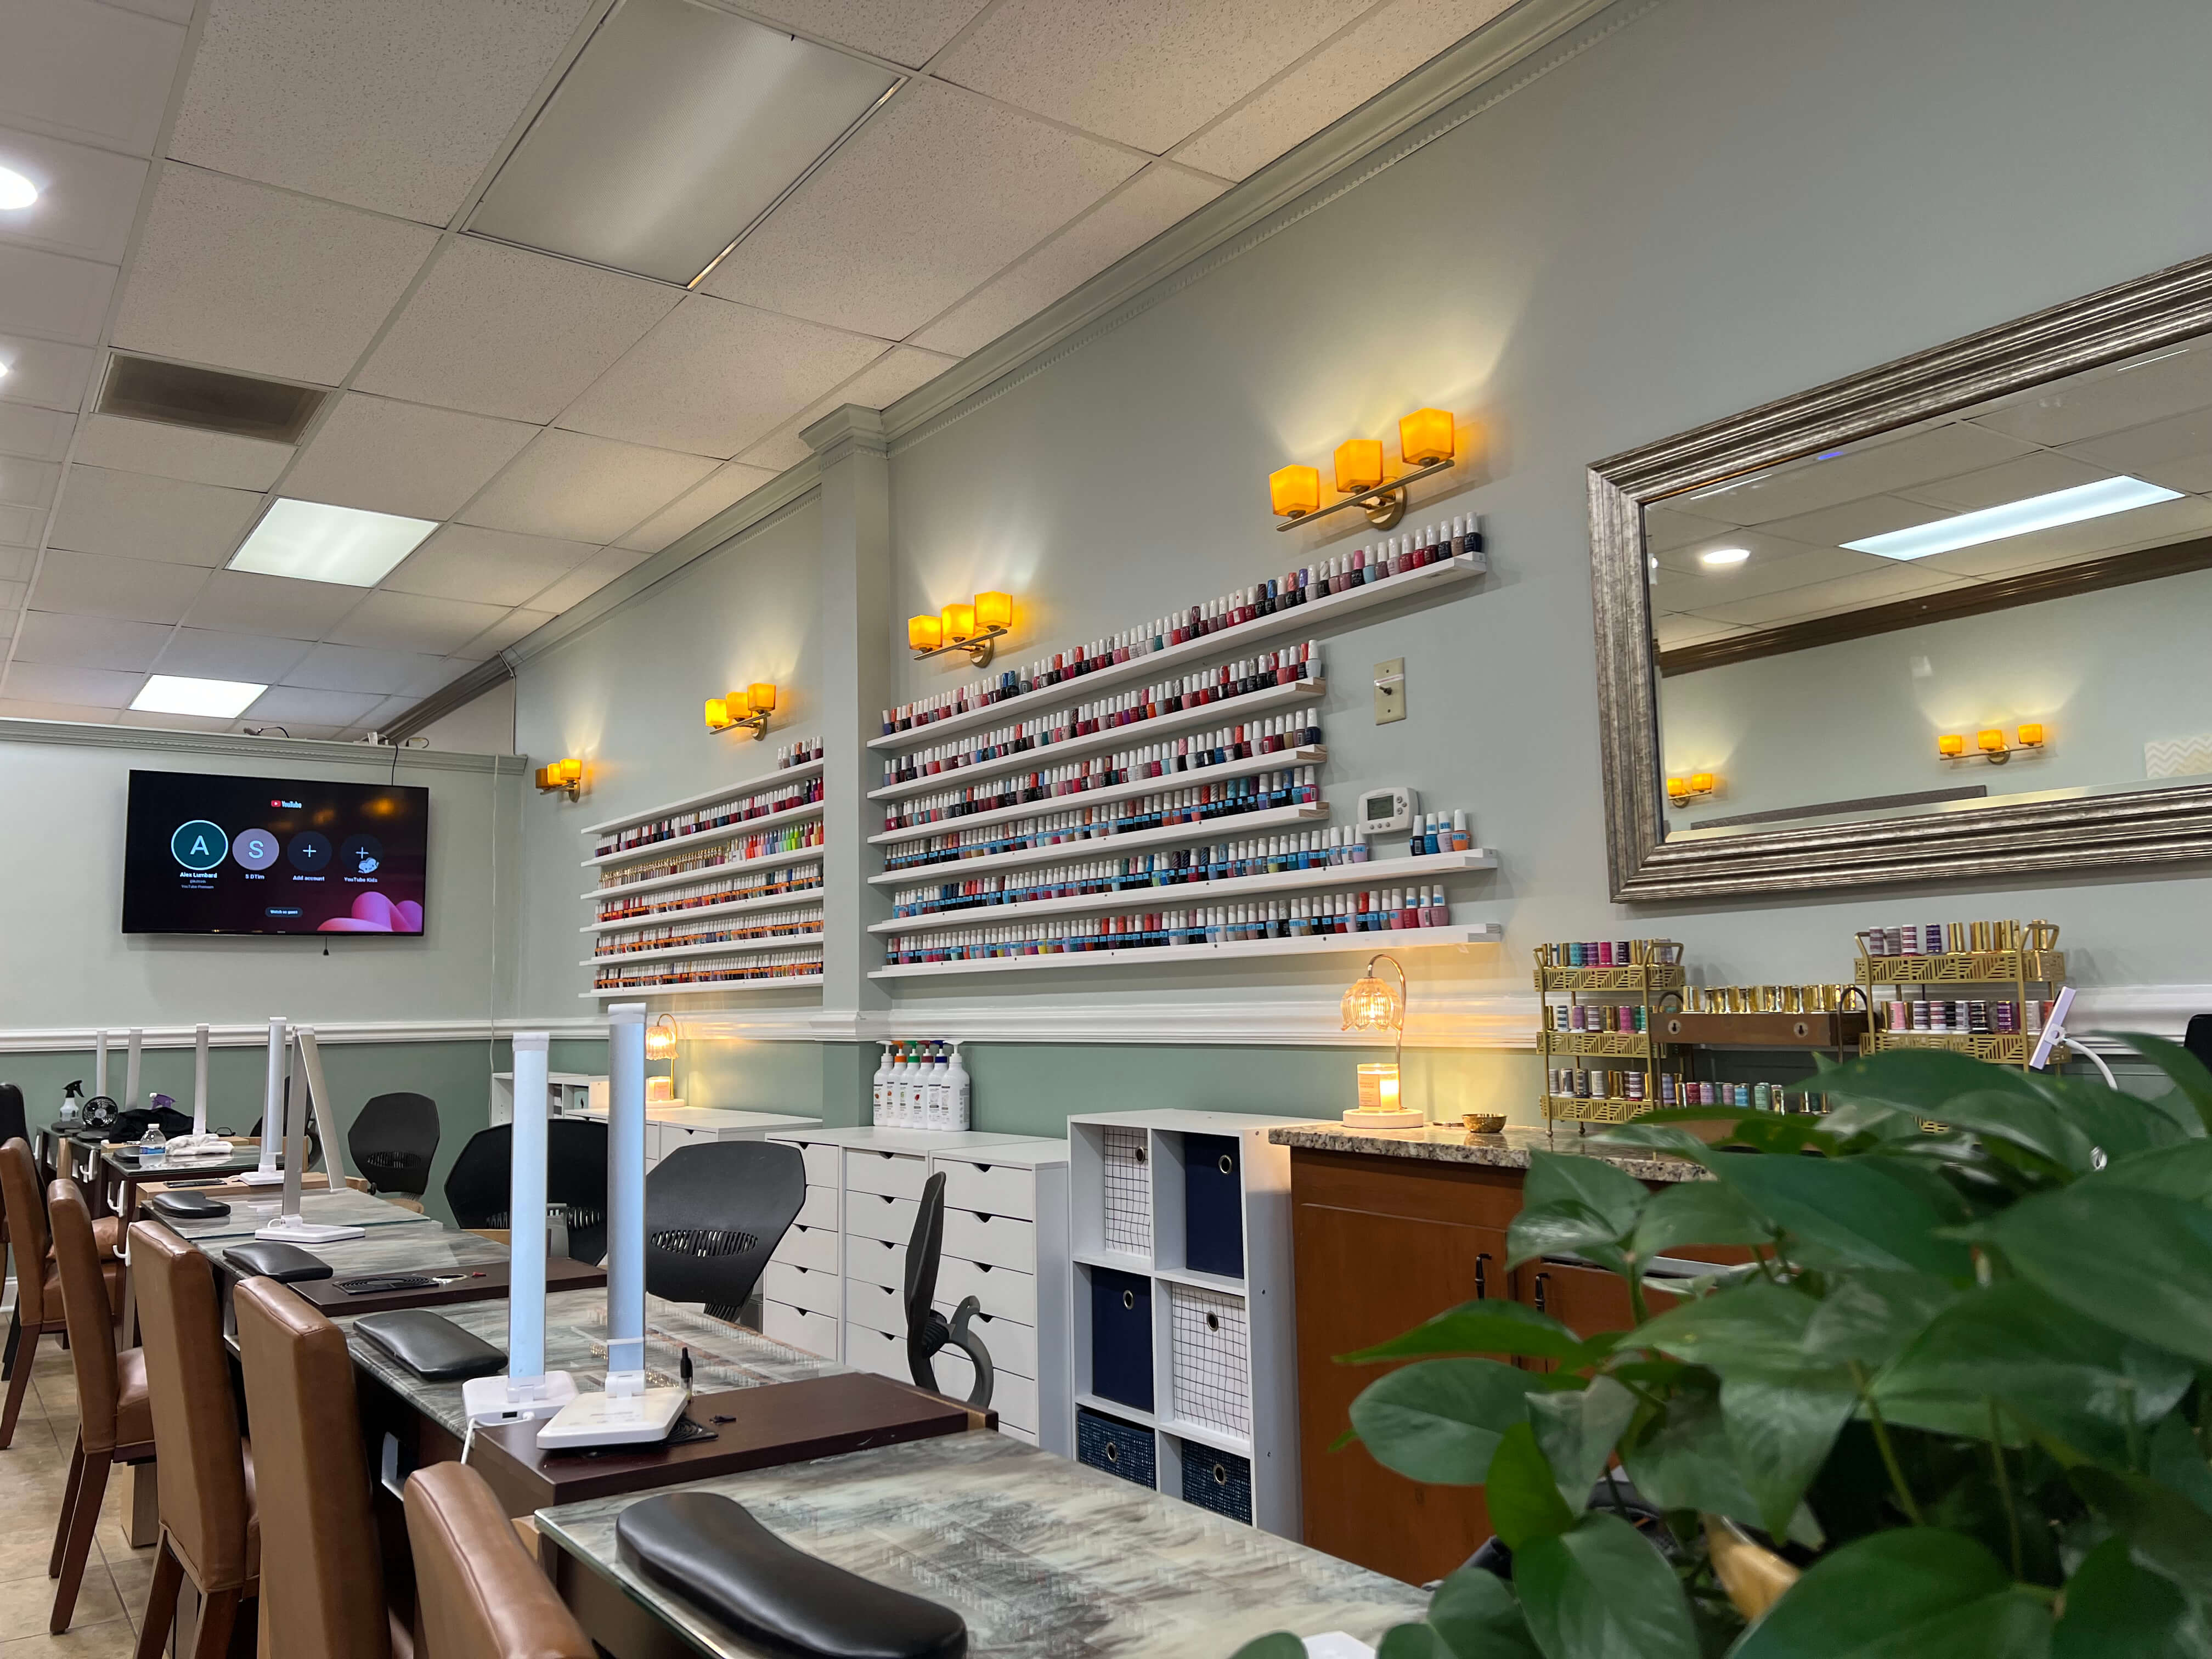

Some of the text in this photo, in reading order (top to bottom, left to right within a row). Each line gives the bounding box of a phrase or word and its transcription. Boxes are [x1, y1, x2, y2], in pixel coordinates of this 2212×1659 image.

[281, 800, 302, 808] YouTube
[190, 835, 210, 856] A
[248, 840, 264, 859] S
